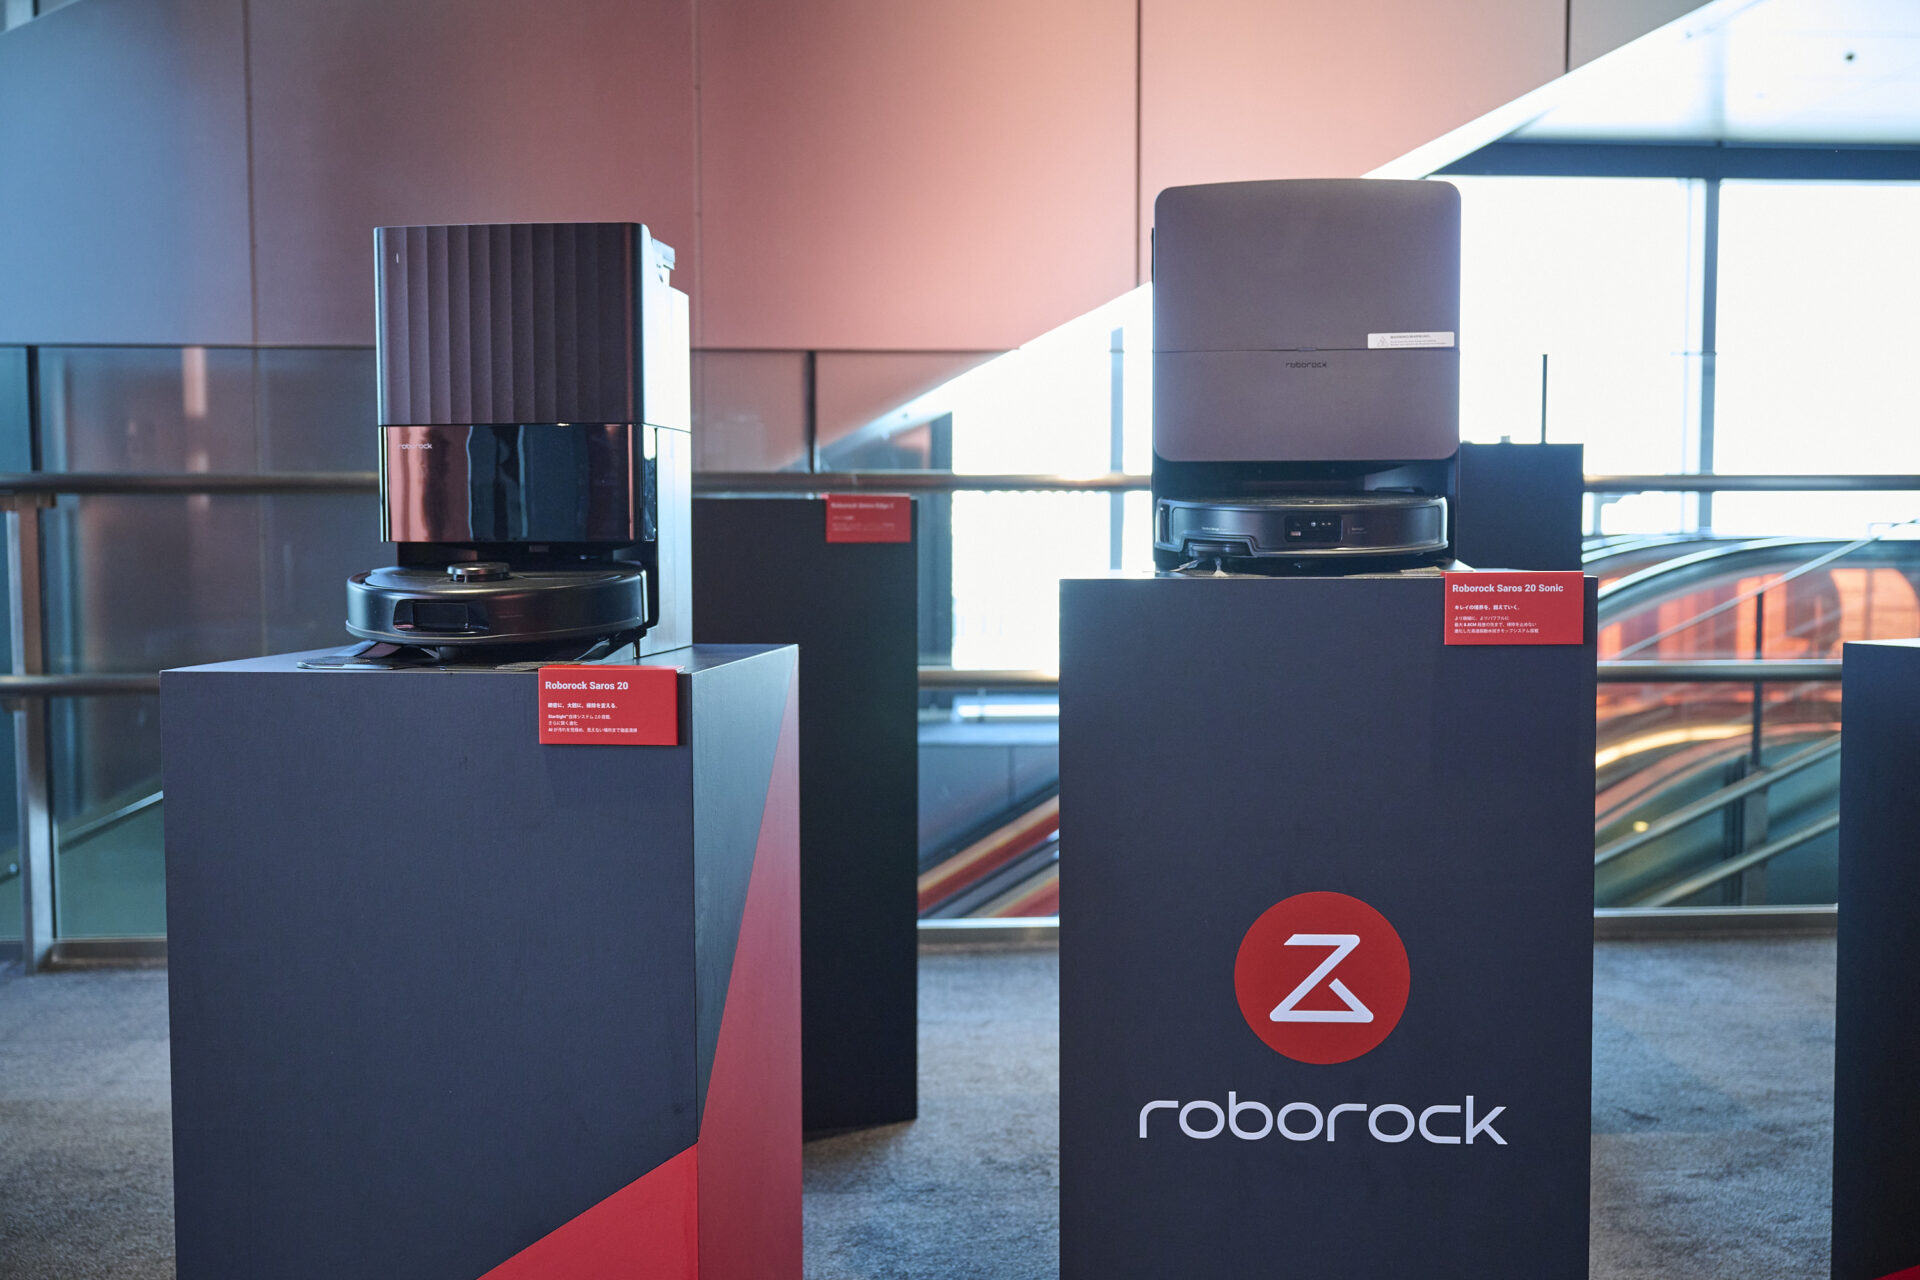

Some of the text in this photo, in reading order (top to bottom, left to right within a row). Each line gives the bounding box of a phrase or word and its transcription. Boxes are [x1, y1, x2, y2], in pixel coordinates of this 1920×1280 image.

[1285, 360, 1328, 369] roborock
[1452, 583, 1564, 593] Roborock Saros 20 Sonic
[545, 680, 629, 690] Roborock Saros 20
[1139, 1091, 1508, 1145] roborock
